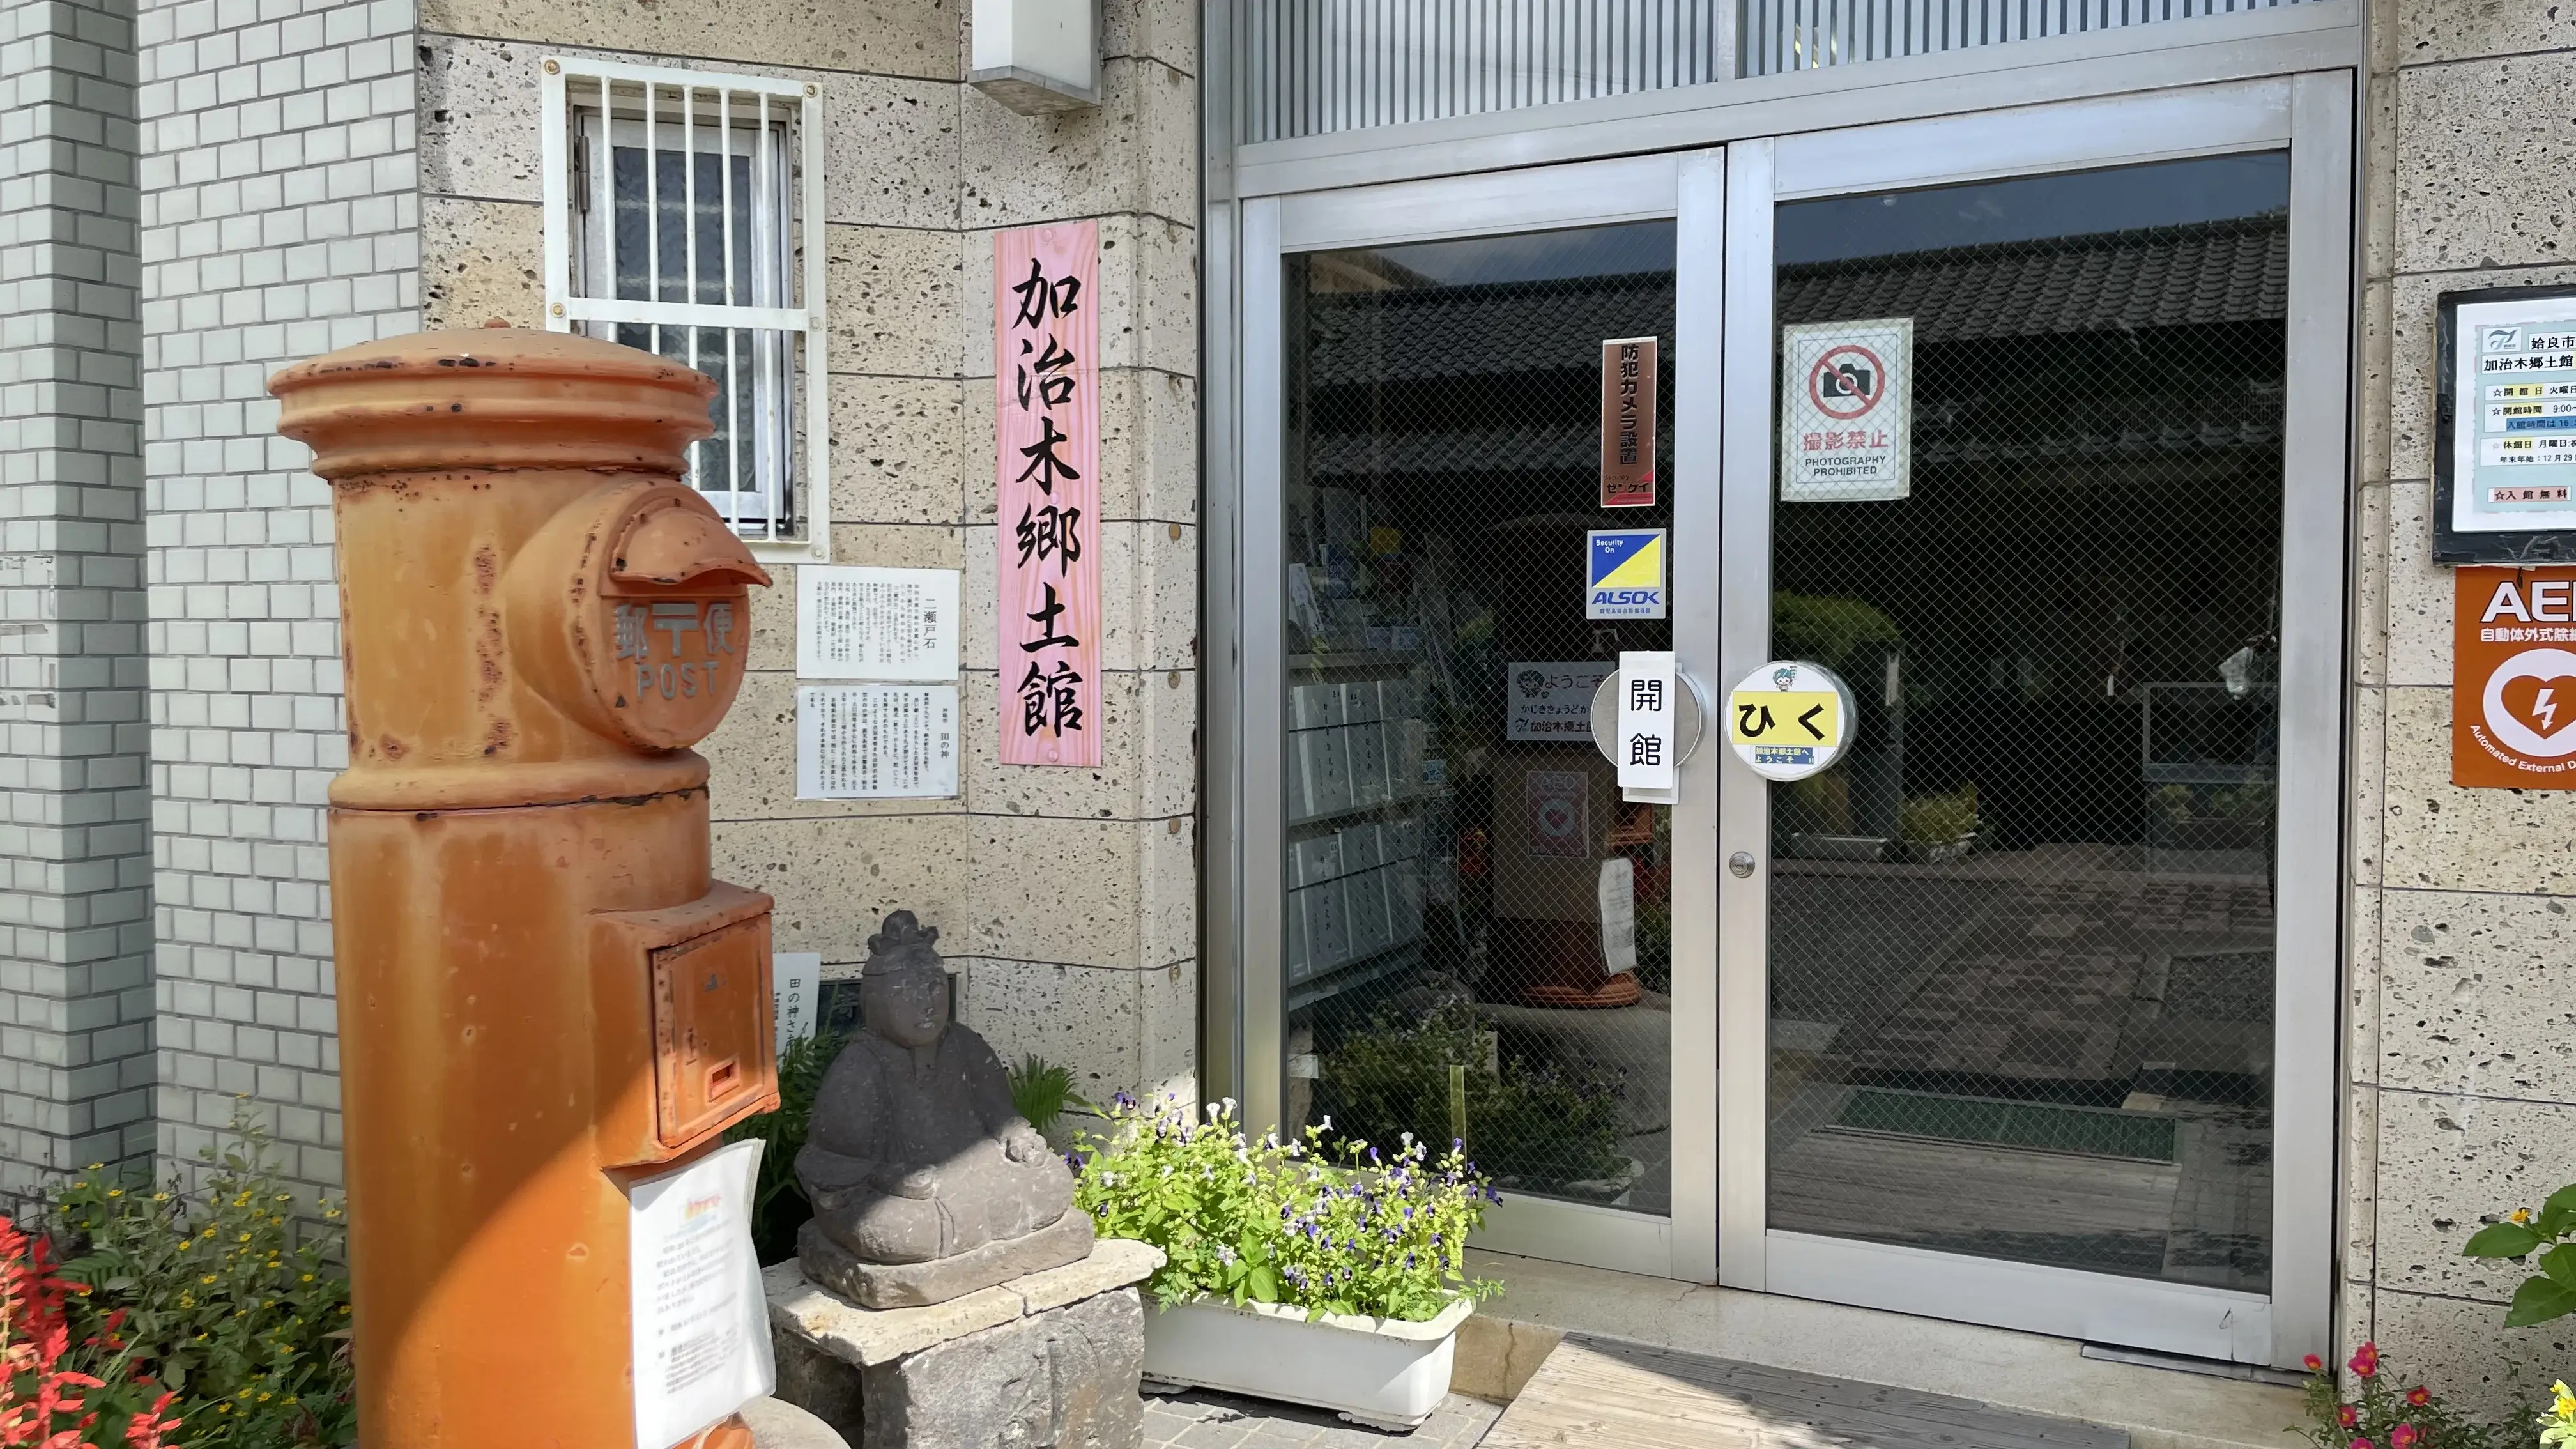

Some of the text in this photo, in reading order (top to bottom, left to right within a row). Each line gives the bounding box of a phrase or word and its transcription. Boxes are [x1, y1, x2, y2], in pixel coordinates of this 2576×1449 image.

[2531, 335, 2576, 350] 姶良市
[2483, 355, 2573, 371] 加治木郷土館
[2504, 387, 2543, 397] 開館日
[1620, 344, 1640, 465] 防犯カメラ設置
[2503, 405, 2543, 415] 開館時間
[2507, 419, 2556, 430] 入館時間は
[1803, 429, 1889, 451] 撮影禁止
[2503, 440, 2533, 450] 休館日
[1805, 456, 1886, 466] PHOTOGRAPHY
[1813, 466, 1877, 477] PROHIBITED
[1607, 482, 1650, 494] ゼンケイ
[2506, 489, 2568, 500] 入館無料
[1012, 258, 1083, 737] 加治木郷土館
[1596, 539, 1624, 548] Security
[1591, 590, 1660, 605] ALSOK
[2480, 580, 2576, 624] AE
[636, 660, 720, 700] POST
[1630, 678, 1662, 766] 開館
[1738, 703, 1825, 741] ひく
[2470, 724, 2517, 767] Automated
[2518, 760, 2565, 772] External
[1755, 755, 1794, 764] ようこそ
